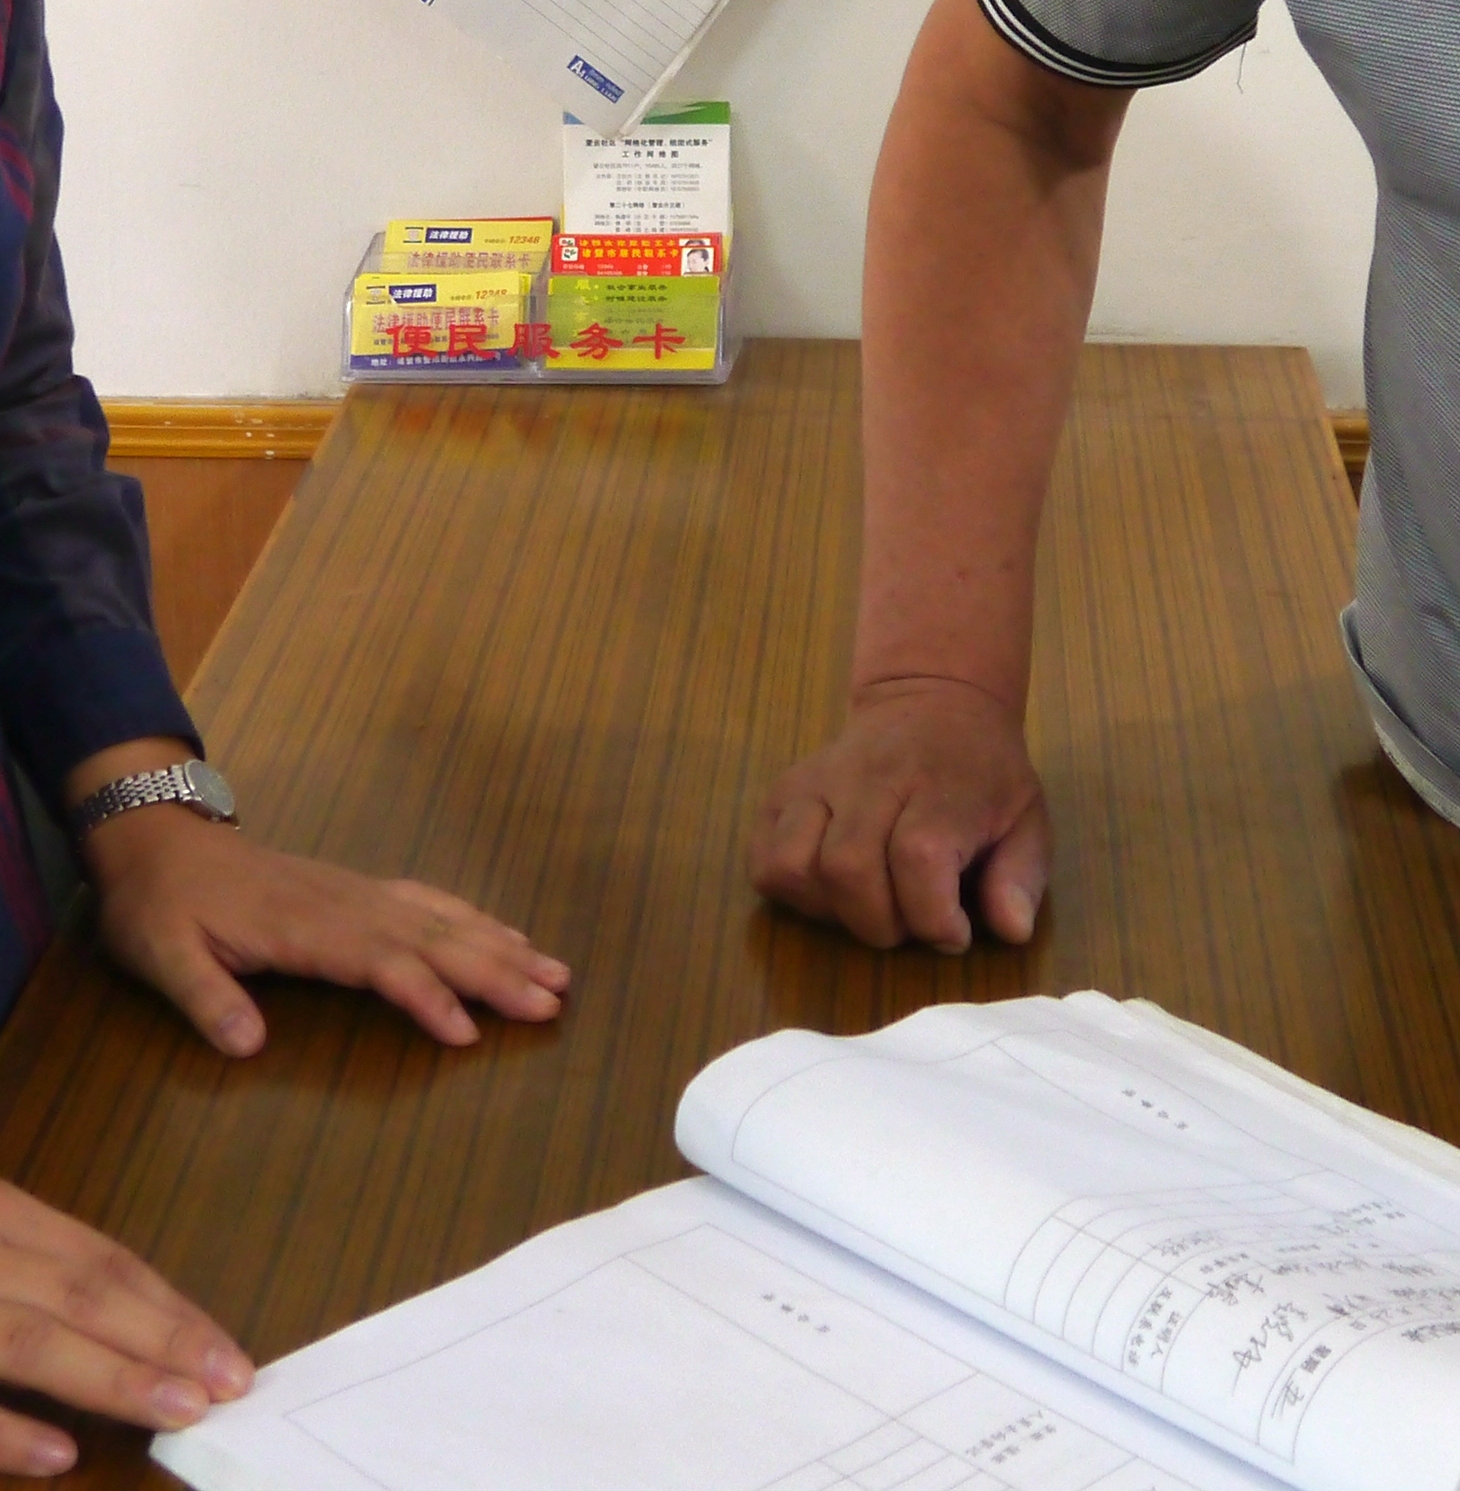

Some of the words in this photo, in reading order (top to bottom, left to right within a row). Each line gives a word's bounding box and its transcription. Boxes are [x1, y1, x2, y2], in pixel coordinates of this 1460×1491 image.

[429, 229, 469, 242] 法律援助
[509, 236, 540, 244] 12348
[386, 322, 687, 361] 便民服务卡
